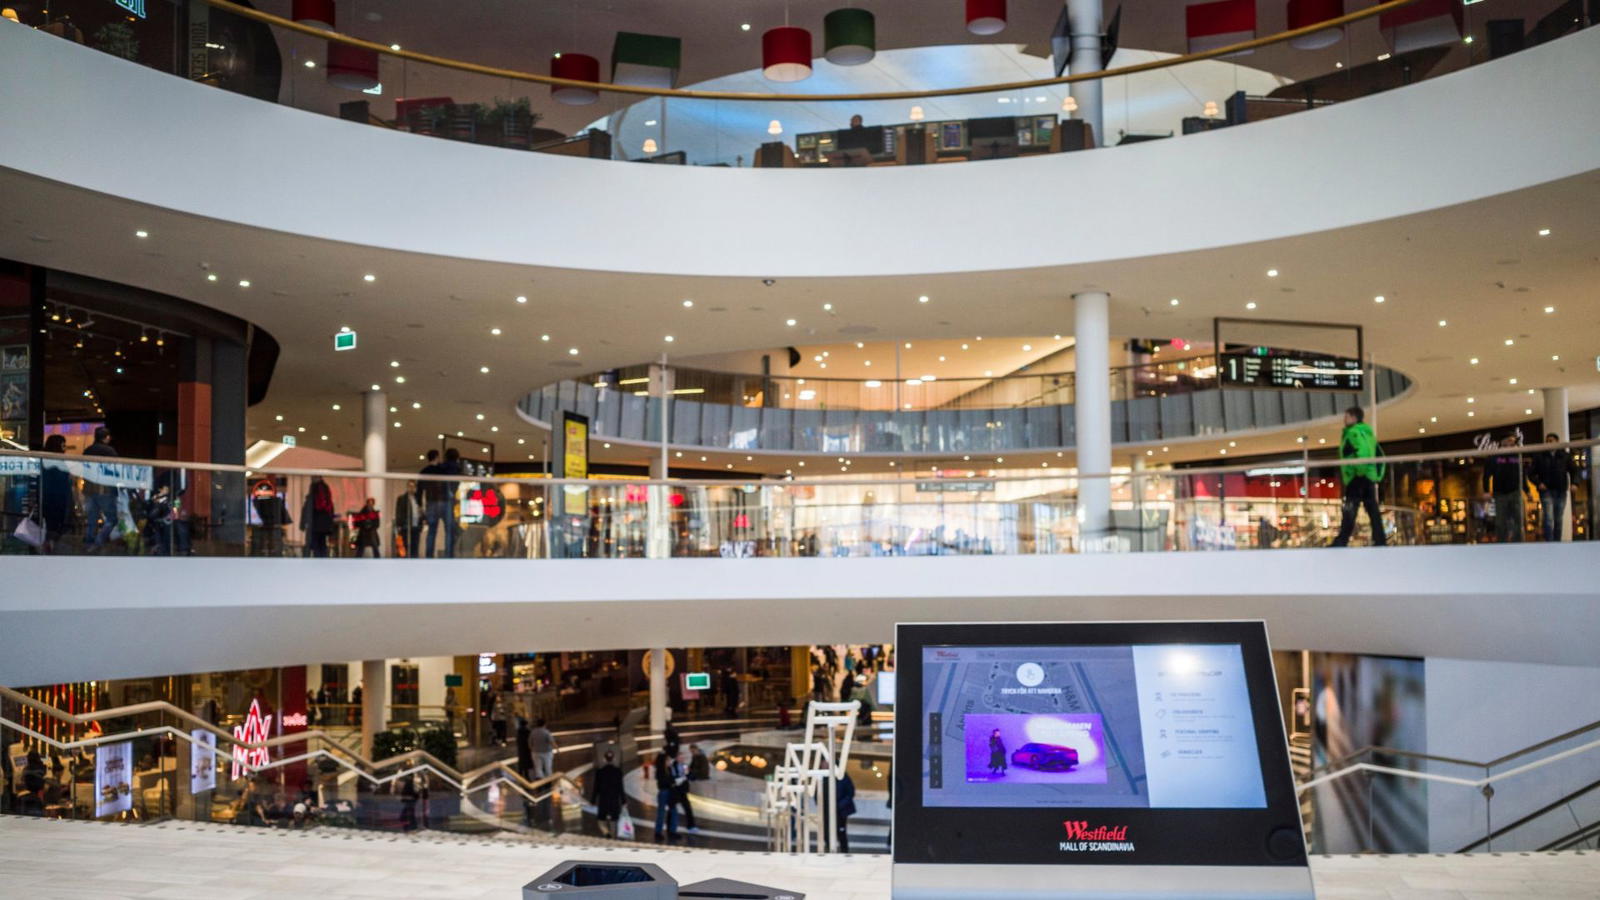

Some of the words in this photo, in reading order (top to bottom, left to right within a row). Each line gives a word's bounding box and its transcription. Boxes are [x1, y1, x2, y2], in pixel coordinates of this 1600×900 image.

[1063, 821, 1128, 840] Westfield
[1060, 842, 1078, 851] MALL
[1079, 842, 1088, 851] OF
[1089, 842, 1135, 852] SCANDINAVIA
